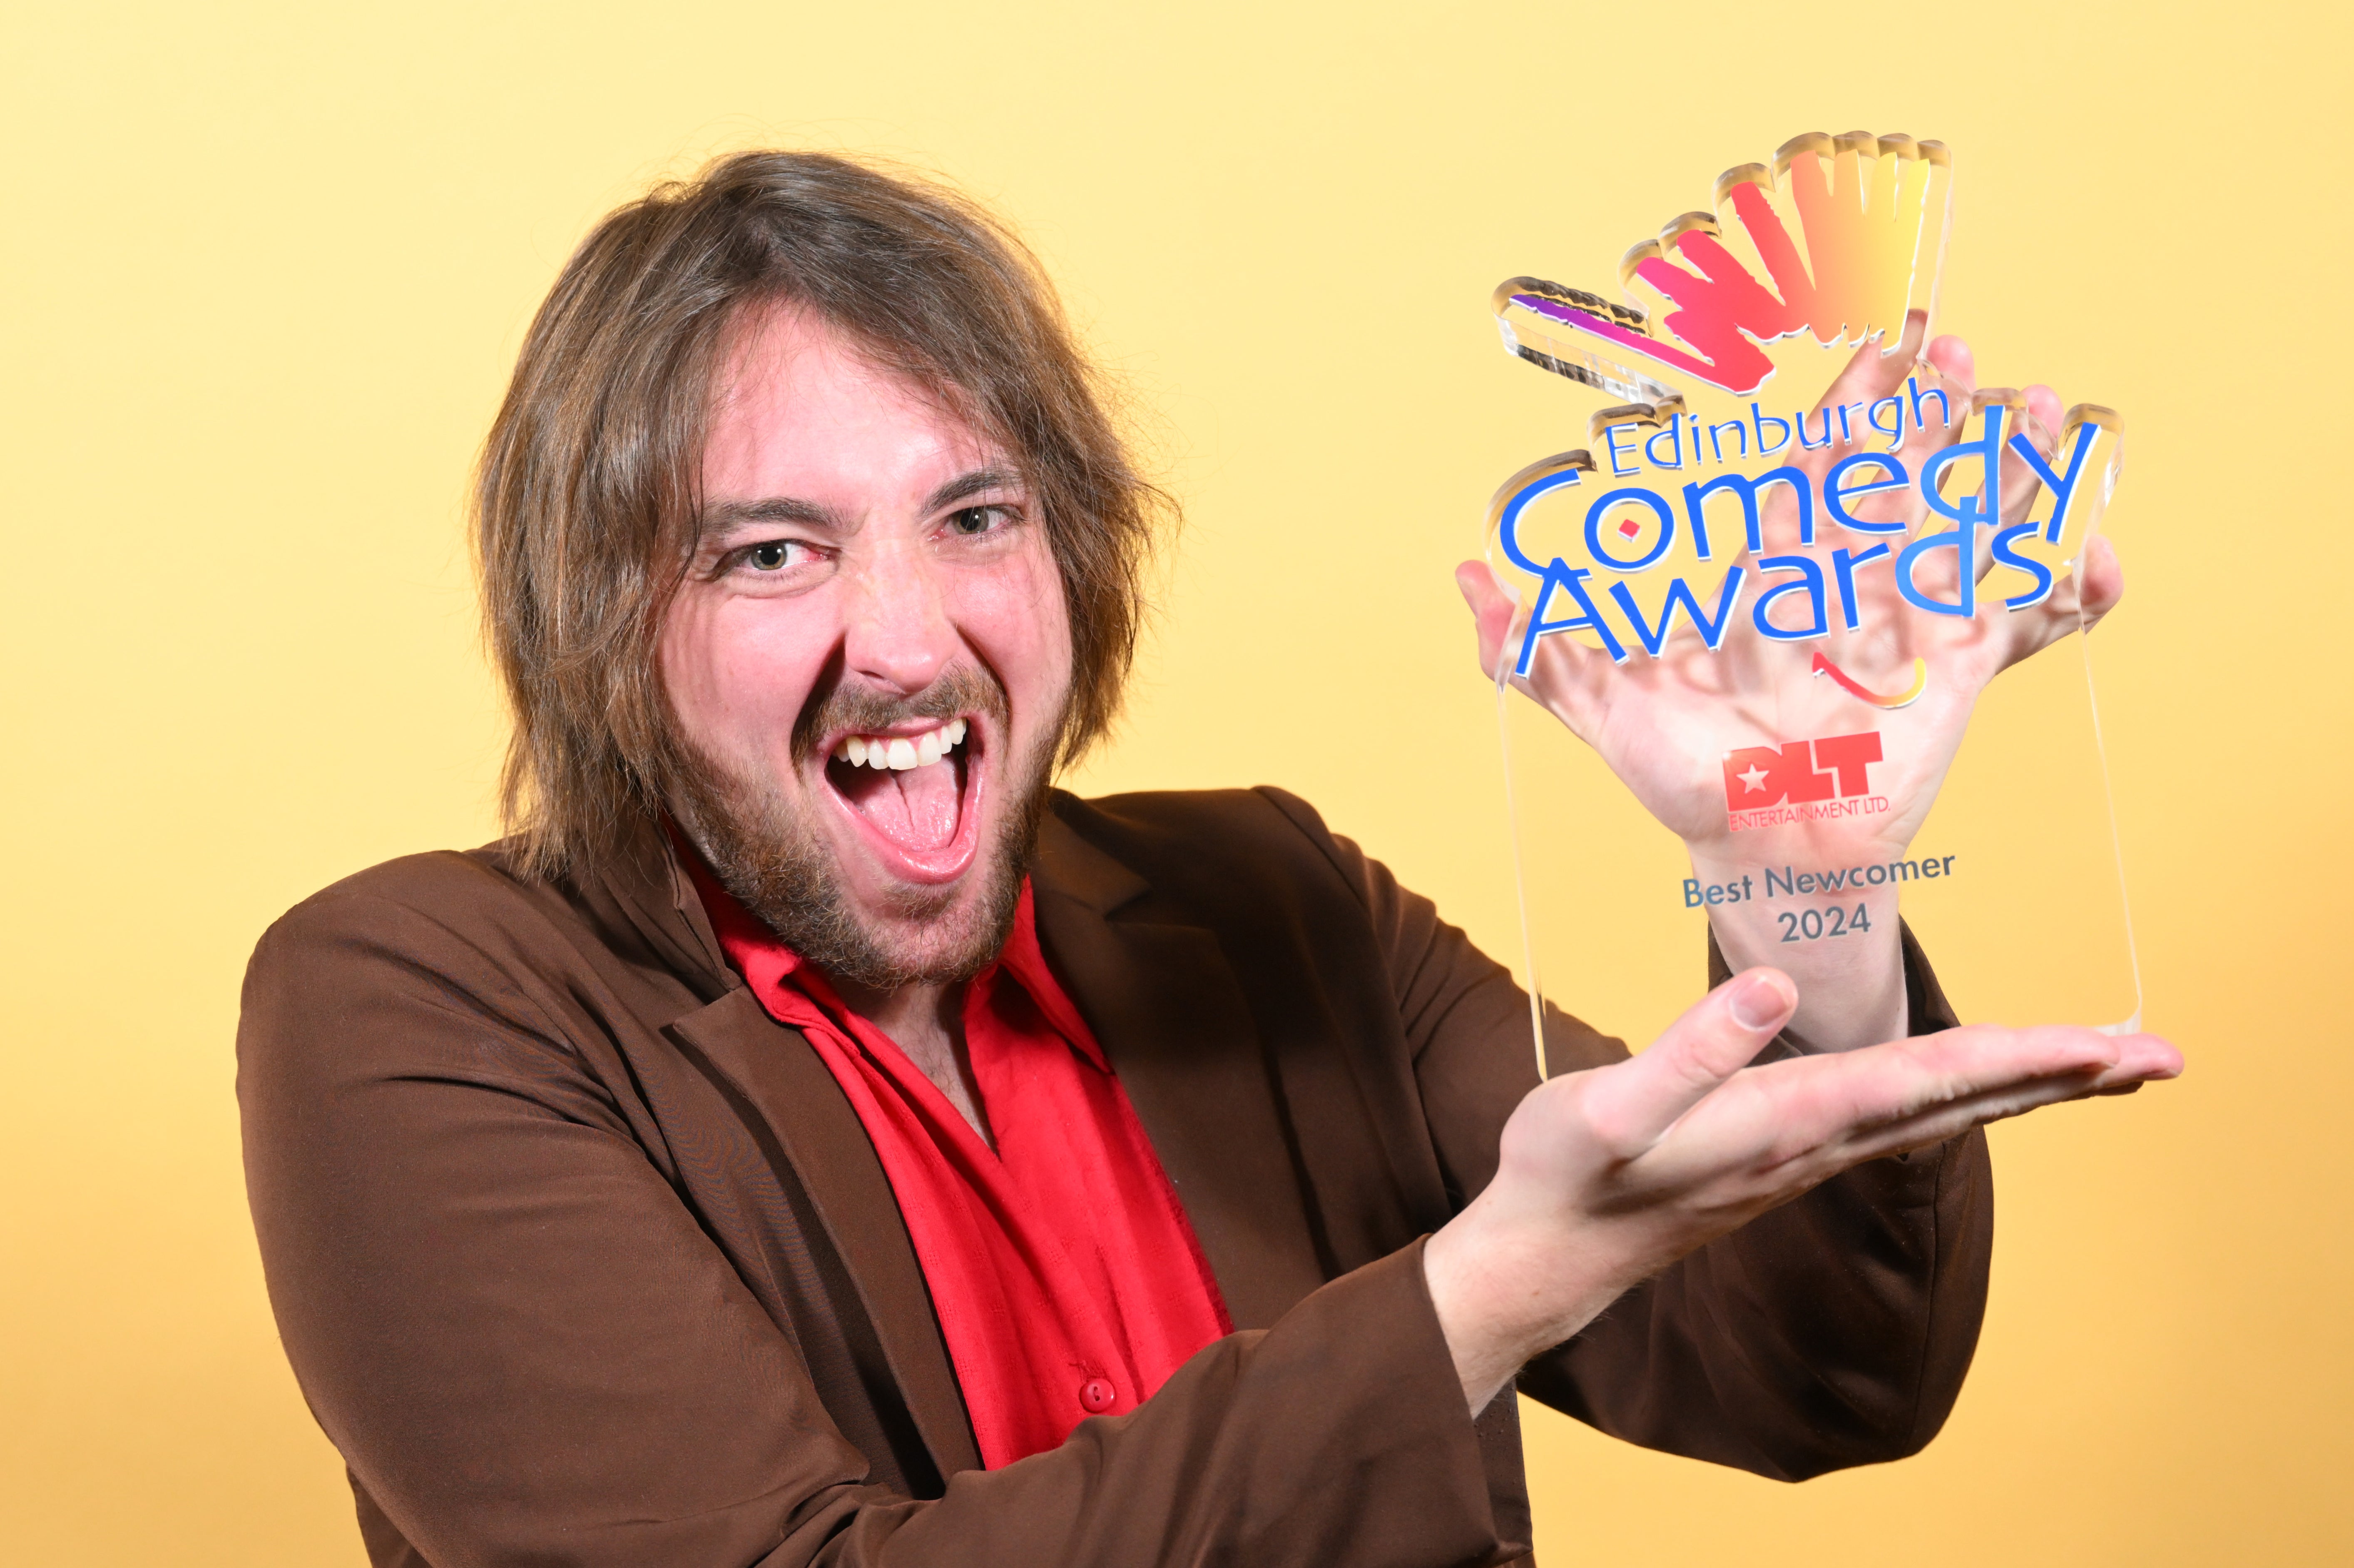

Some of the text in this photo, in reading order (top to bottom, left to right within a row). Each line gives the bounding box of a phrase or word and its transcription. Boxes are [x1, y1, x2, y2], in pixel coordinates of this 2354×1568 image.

[1605, 377, 1951, 477] Edinburgh
[1500, 405, 2102, 581] Comedy
[1515, 497, 2054, 679] Awards
[1722, 731, 1883, 812] DLT
[1729, 796, 1891, 832] ENTERTAINMENT LTD.
[1683, 855, 1956, 908] Best Newcomer
[1778, 902, 1871, 943] 2024
